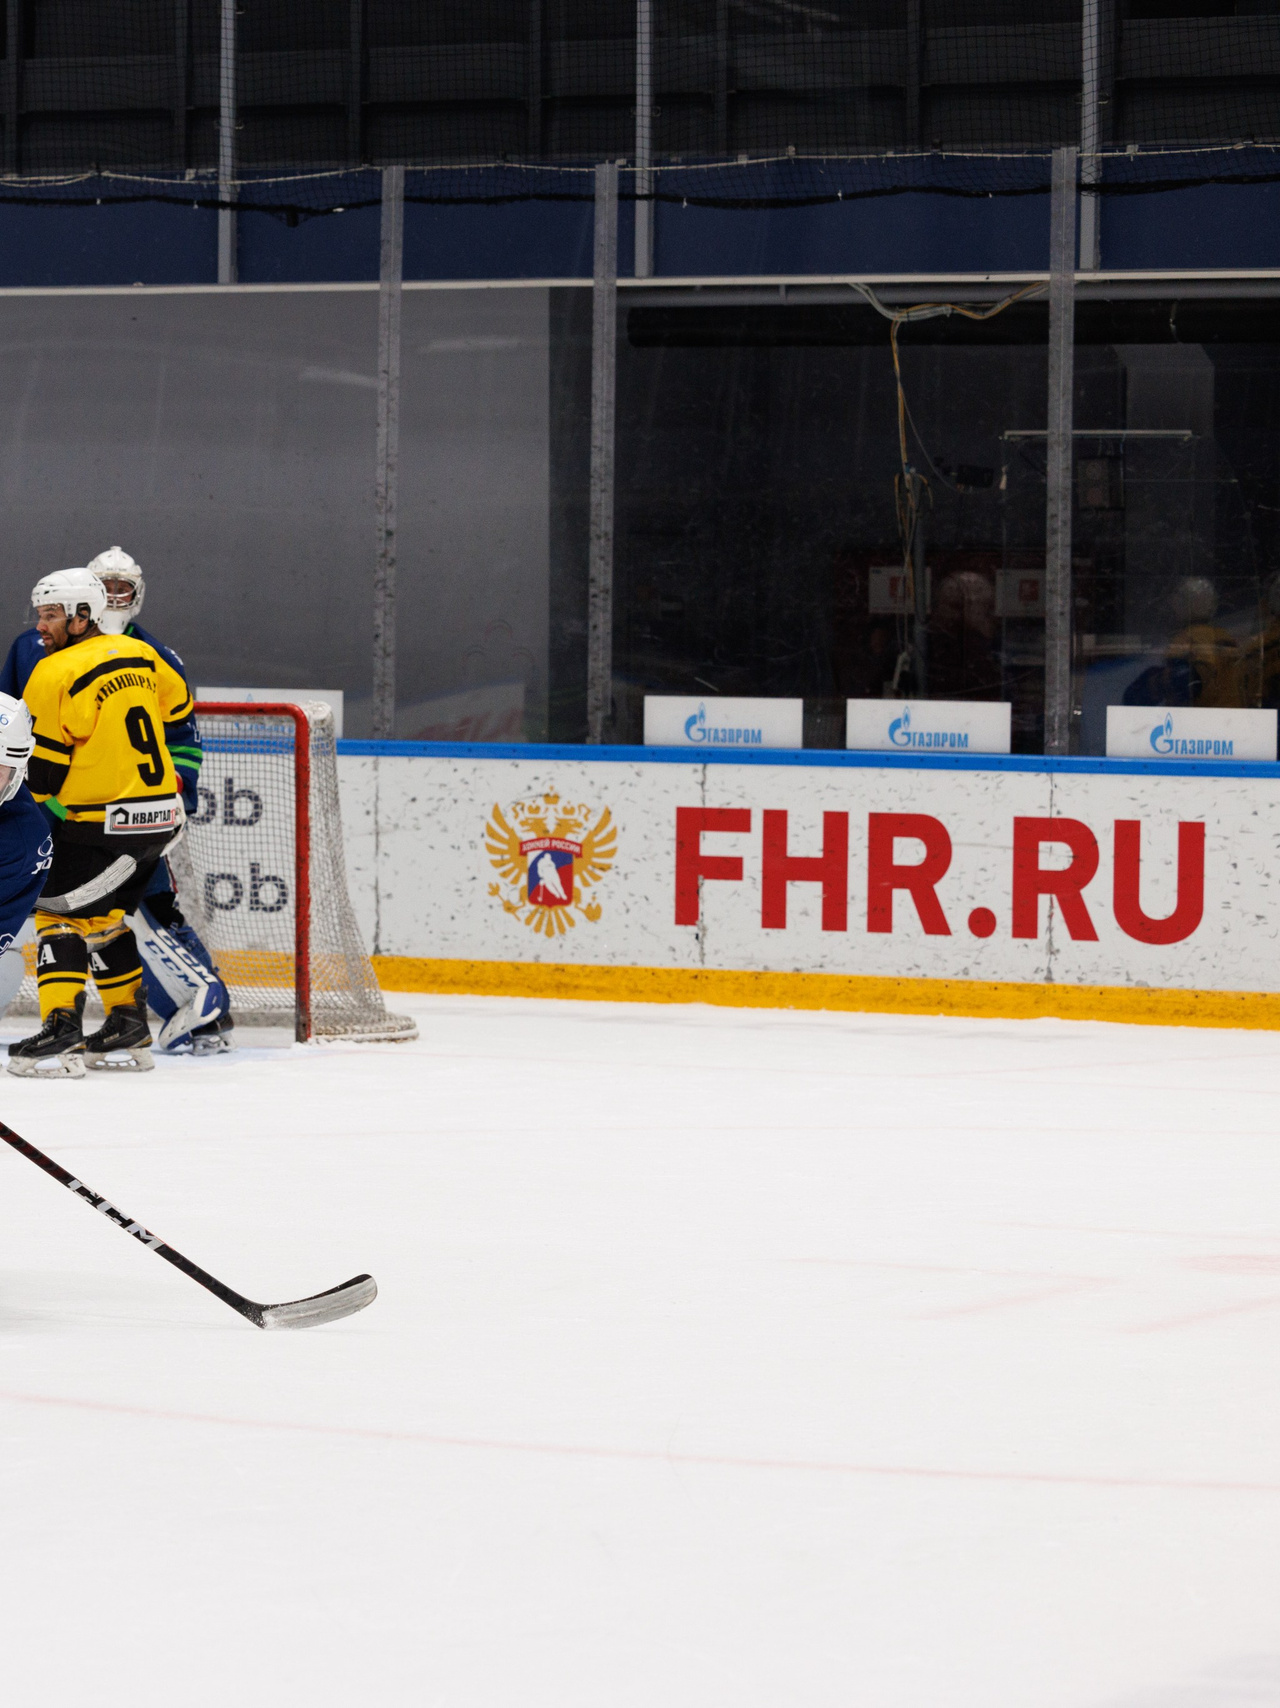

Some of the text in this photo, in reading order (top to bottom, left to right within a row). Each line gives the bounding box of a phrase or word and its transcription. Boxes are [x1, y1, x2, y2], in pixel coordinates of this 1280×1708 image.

[124, 705, 165, 787] 9
[706, 728, 762, 744] ГАЗПРОМ
[912, 731, 969, 748] ГАЗПРОМ
[1173, 739, 1234, 756] ГАЗПРОМ
[674, 806, 1206, 946] FHR.RU
[144, 939, 200, 988] CCM
[155, 928, 220, 984] CCM
[67, 1178, 167, 1251] CCM
